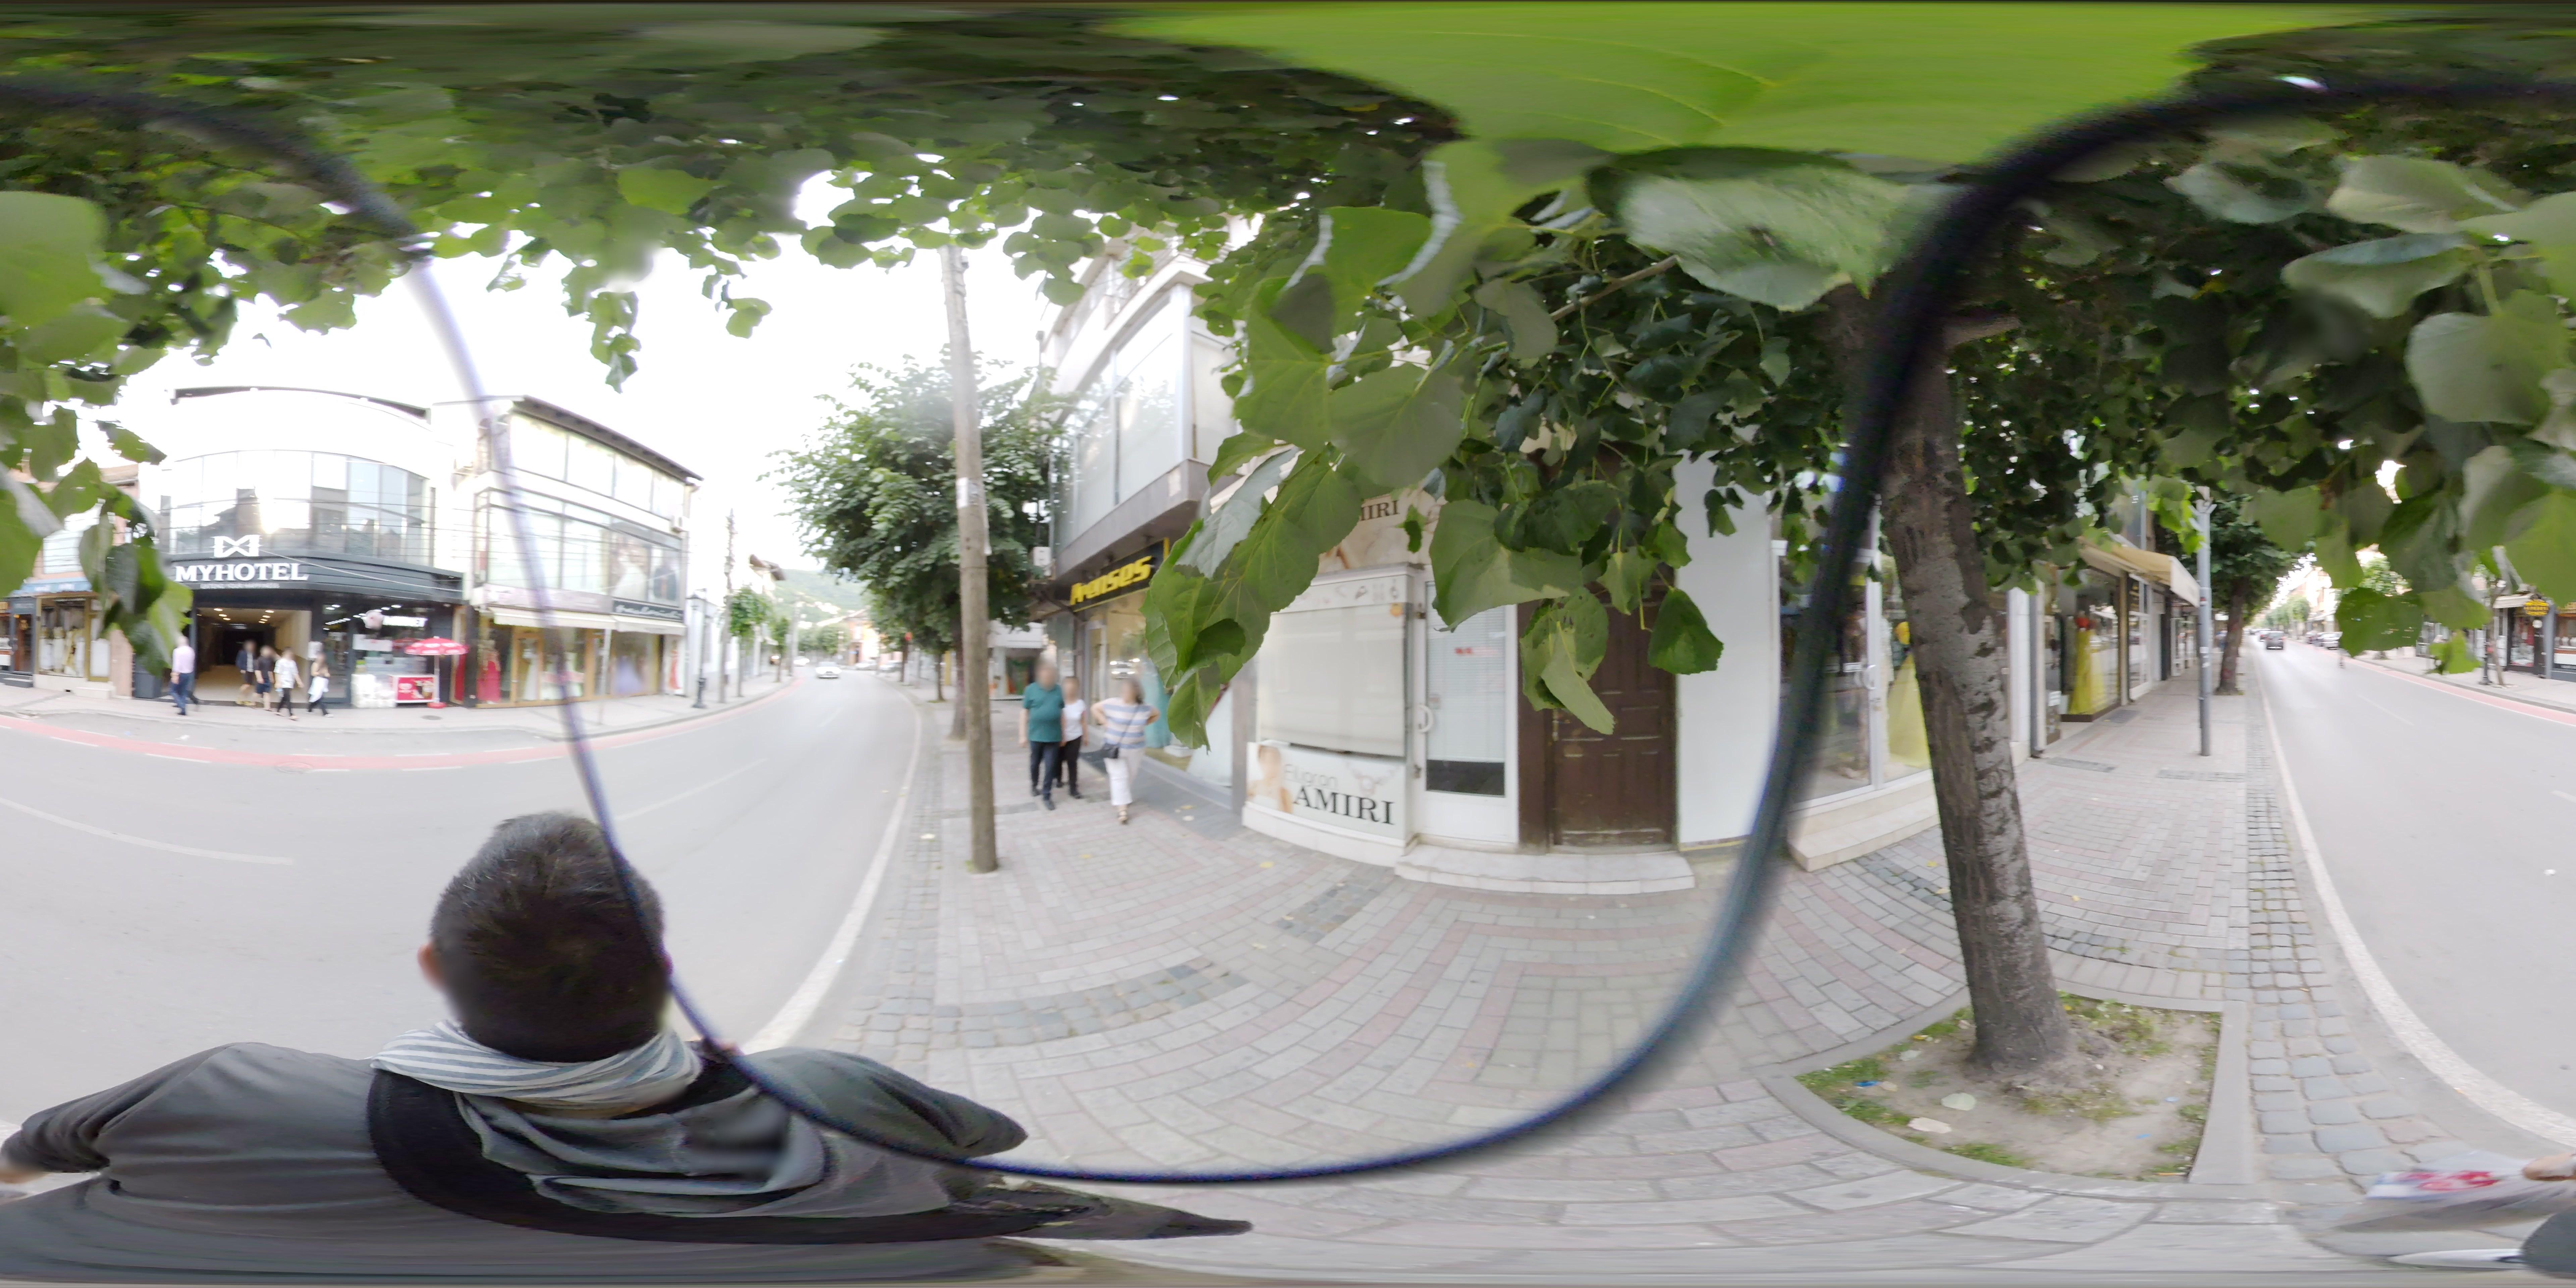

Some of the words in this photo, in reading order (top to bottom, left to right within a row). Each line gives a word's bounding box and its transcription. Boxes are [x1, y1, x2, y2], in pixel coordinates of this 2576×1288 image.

[1361, 500, 1400, 521] IRI
[174, 563, 309, 582] MYHOTEL
[1293, 786, 1395, 825] AMIRI
